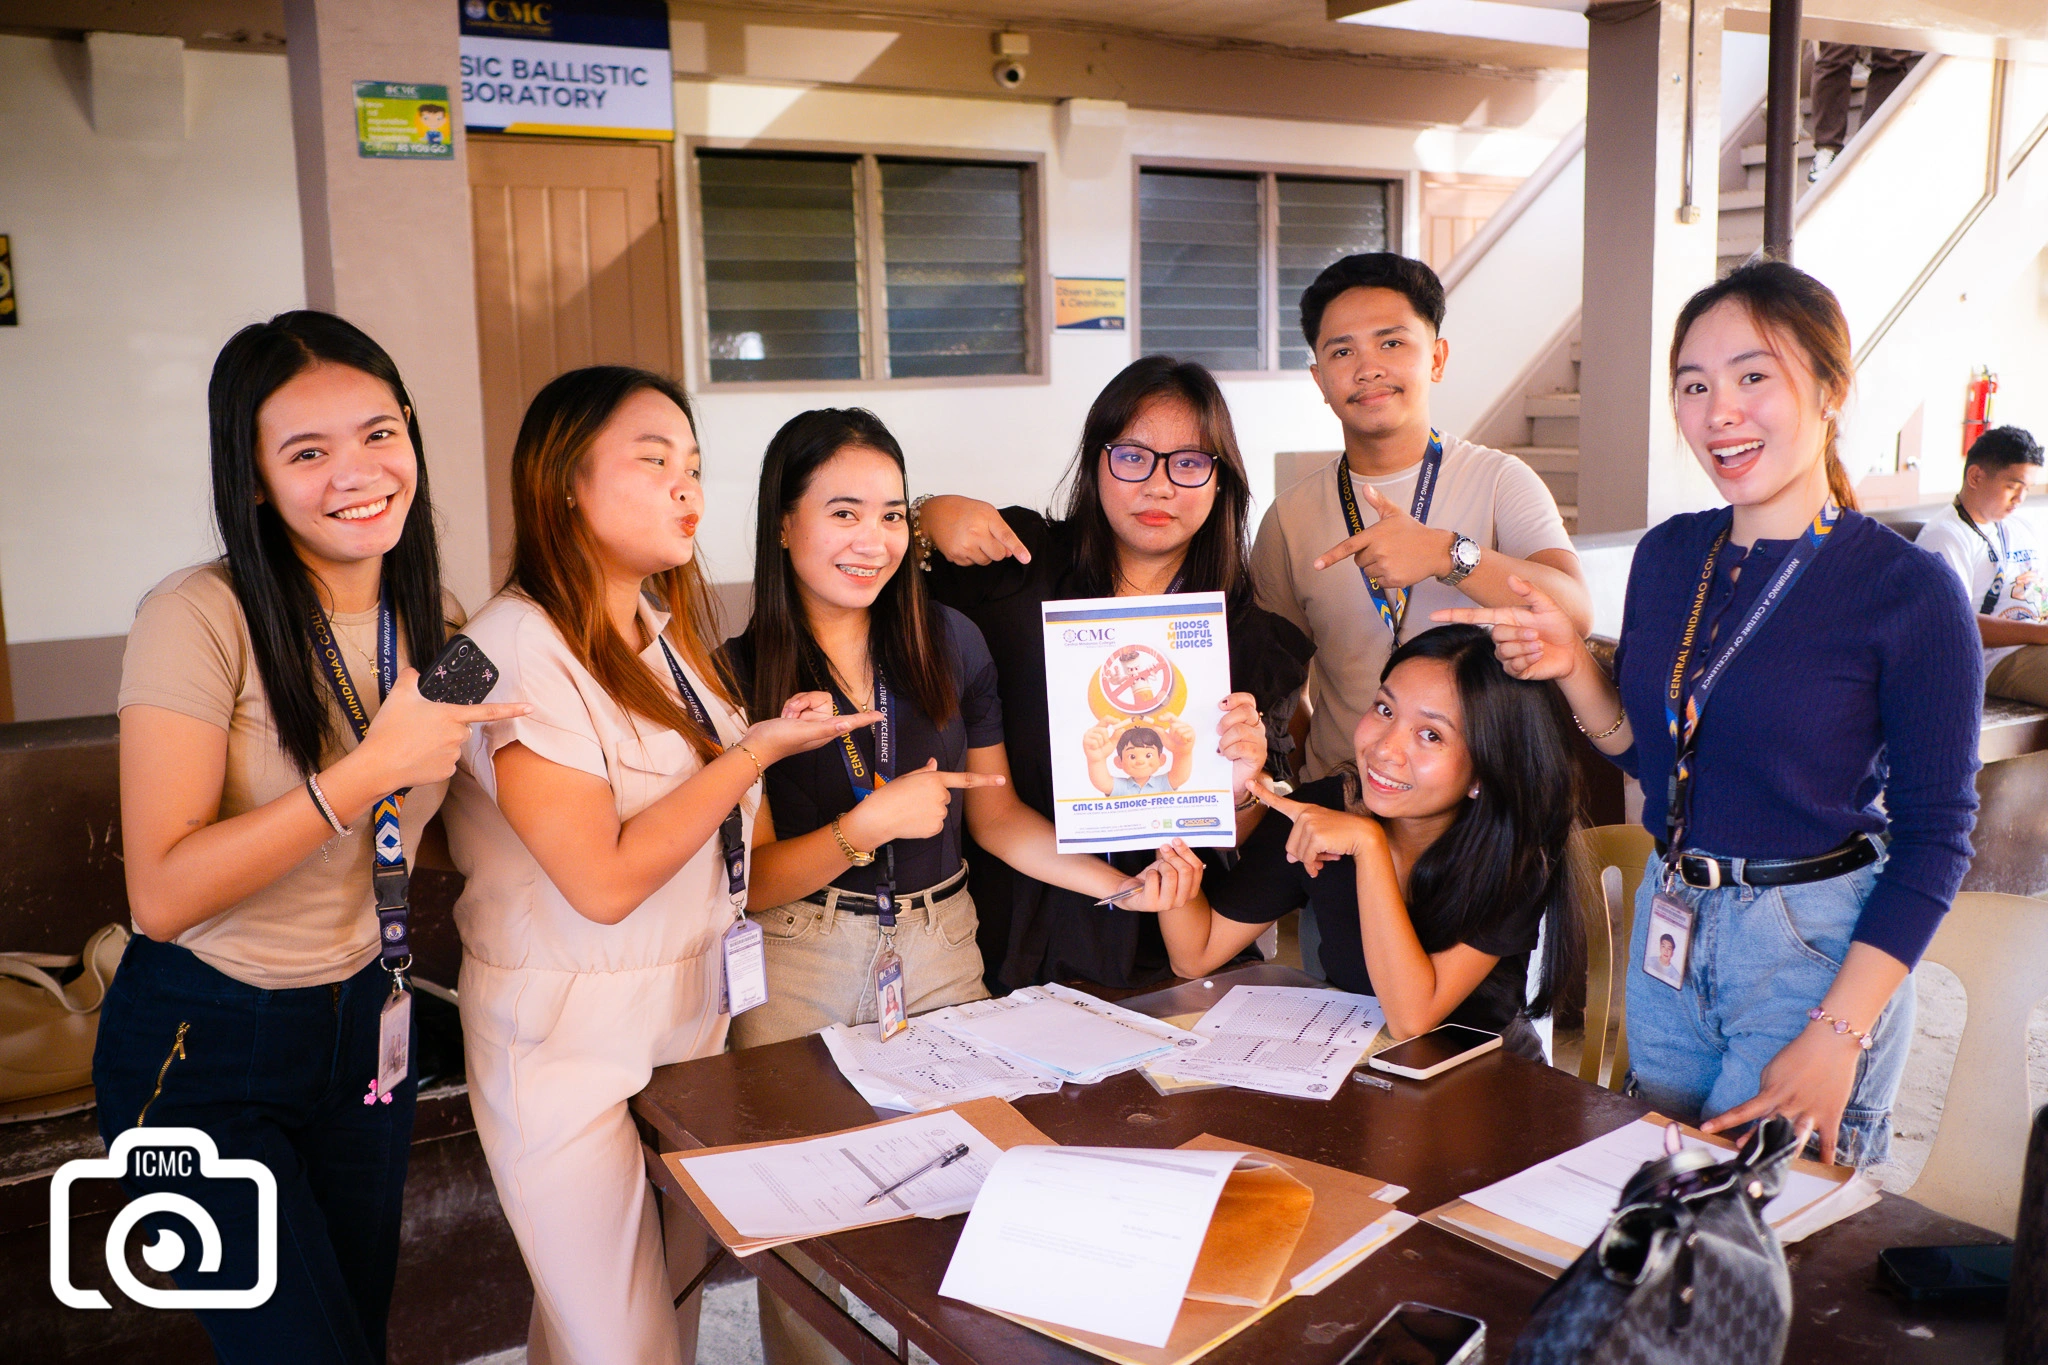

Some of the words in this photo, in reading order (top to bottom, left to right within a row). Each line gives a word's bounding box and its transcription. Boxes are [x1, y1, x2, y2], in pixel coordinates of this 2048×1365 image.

[486, 0, 551, 25] CMC
[461, 55, 502, 77] SIC
[513, 59, 648, 86] BALLISTIC
[461, 82, 607, 109] BORATORY
[1421, 462, 1434, 496] NURTURING
[1768, 558, 1800, 599] NURTURING
[1762, 598, 1771, 606] A
[383, 609, 391, 656] NURTURING
[1077, 628, 1115, 641] CMC
[1740, 606, 1766, 636] CULTURE
[1670, 649, 1690, 699] CENTRAL
[1682, 582, 1708, 647] MINDANAO
[1733, 636, 1744, 648] OF
[1701, 646, 1736, 690] EXCELLENCE
[325, 648, 363, 720] MINDANAO
[680, 682, 705, 723] EXCELLENCE
[1094, 802, 1104, 811] IS
[1105, 802, 1113, 810] A
